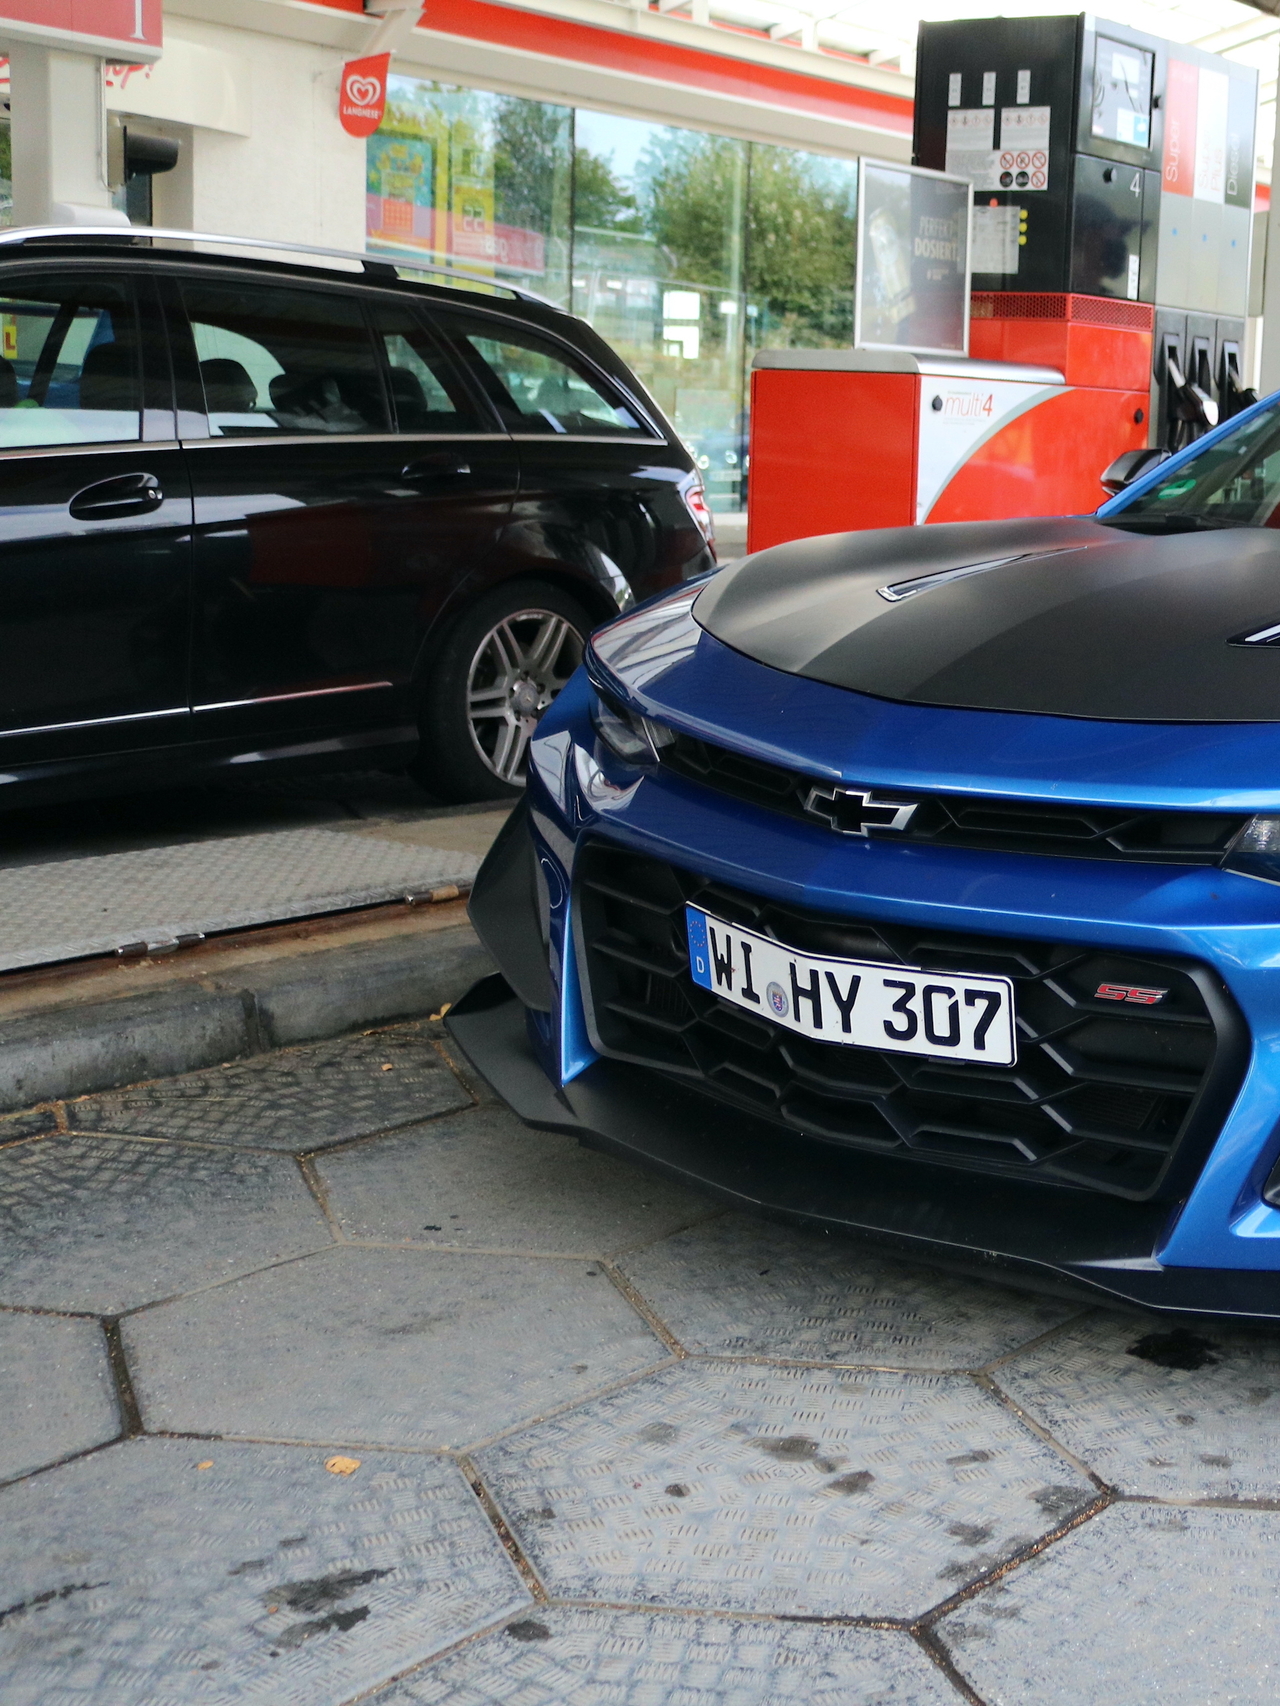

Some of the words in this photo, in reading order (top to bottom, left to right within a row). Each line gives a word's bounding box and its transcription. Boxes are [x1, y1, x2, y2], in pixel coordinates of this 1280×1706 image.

[343, 105, 380, 120] LANGNESE
[1165, 121, 1181, 182] Super
[1227, 133, 1240, 196] Diesel
[1130, 172, 1142, 198] 4
[696, 956, 705, 974] D
[709, 926, 760, 1005] WI
[789, 961, 861, 1034] HY
[883, 979, 1001, 1050] 307
[1094, 983, 1167, 1005] SS
